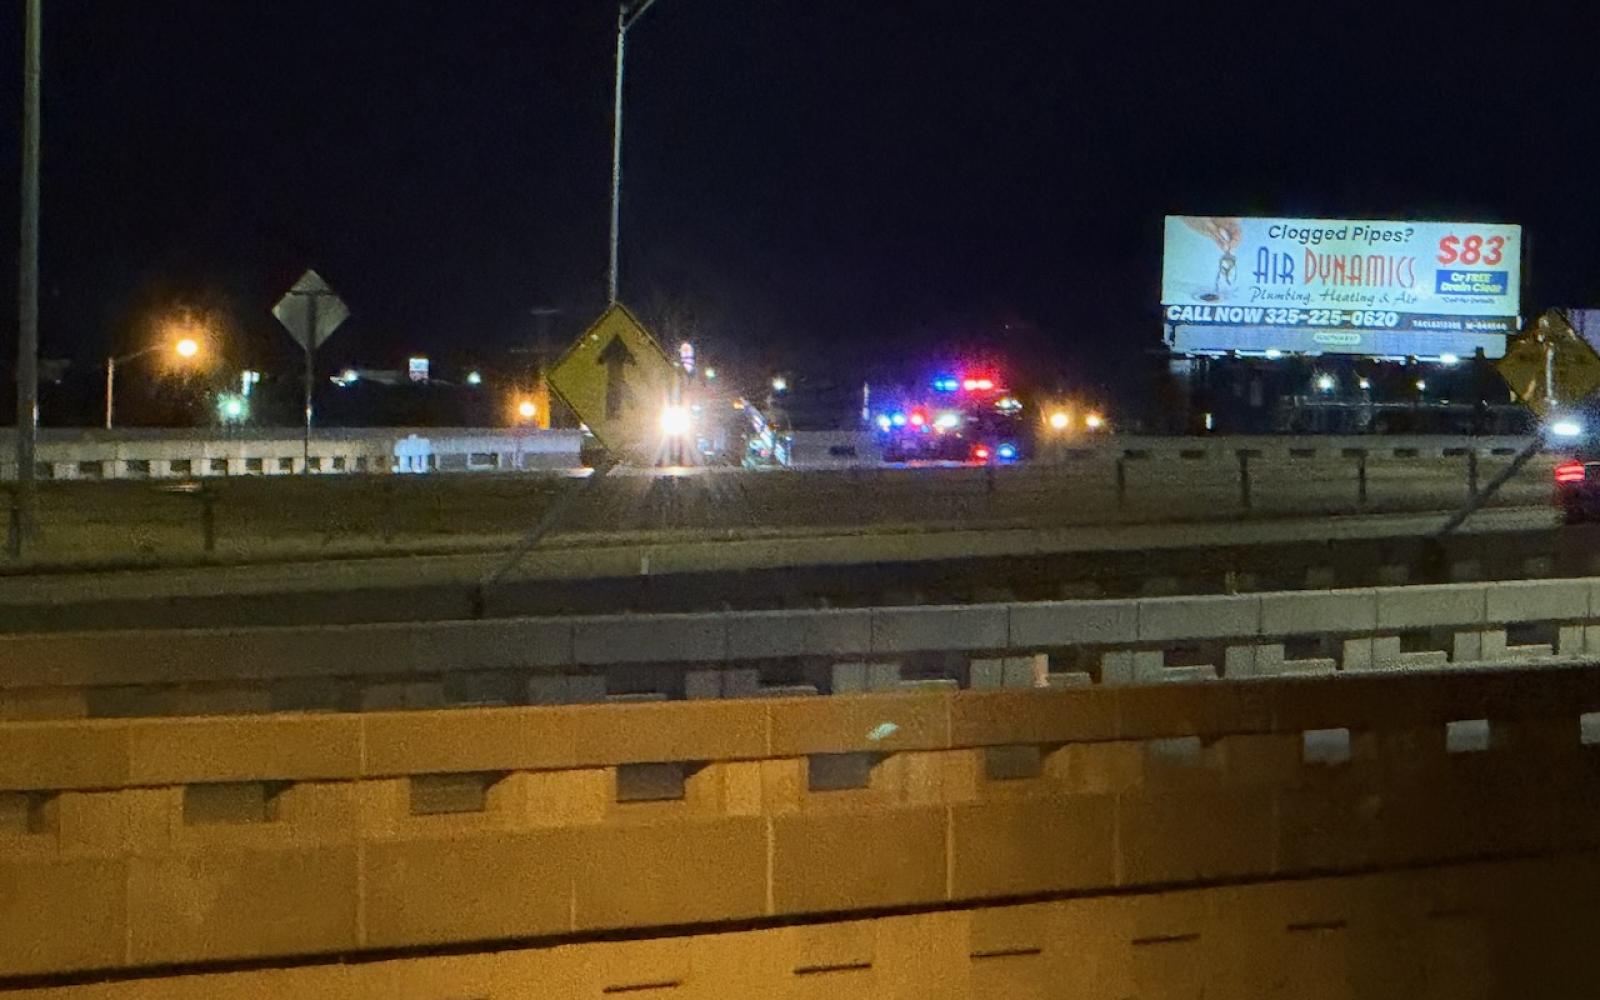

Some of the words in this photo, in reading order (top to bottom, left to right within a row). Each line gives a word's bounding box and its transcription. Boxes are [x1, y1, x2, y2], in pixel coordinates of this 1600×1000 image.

[1268, 225, 1348, 245] Clogged
[1351, 225, 1415, 246] Pipes?
[1252, 246, 1295, 285] AIR
[1304, 246, 1417, 288] DYNAMICS
[1320, 288, 1375, 306] Heating
[1393, 290, 1418, 305] Air
[1167, 305, 1212, 321] CALL
[1215, 307, 1264, 323] NOW
[1265, 308, 1399, 327] 325-225-0620
